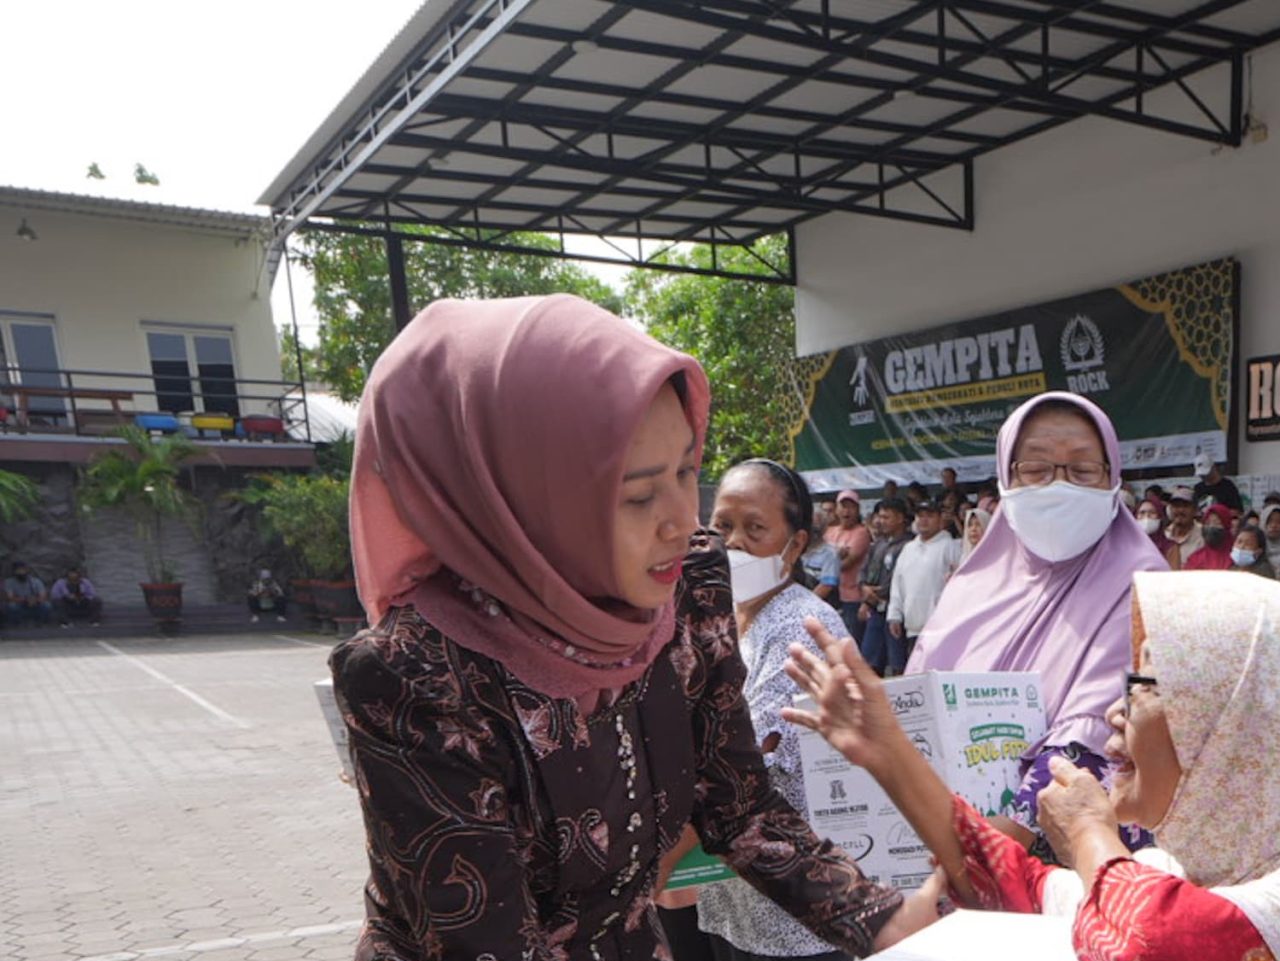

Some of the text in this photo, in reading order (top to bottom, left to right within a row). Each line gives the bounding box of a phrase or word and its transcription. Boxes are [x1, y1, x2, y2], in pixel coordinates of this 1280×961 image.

[884, 324, 1043, 394] GEMPITA
[1066, 370, 1111, 394] ROCK
[964, 687, 1019, 699] GEMPITA
[964, 742, 1001, 768] IDUL
